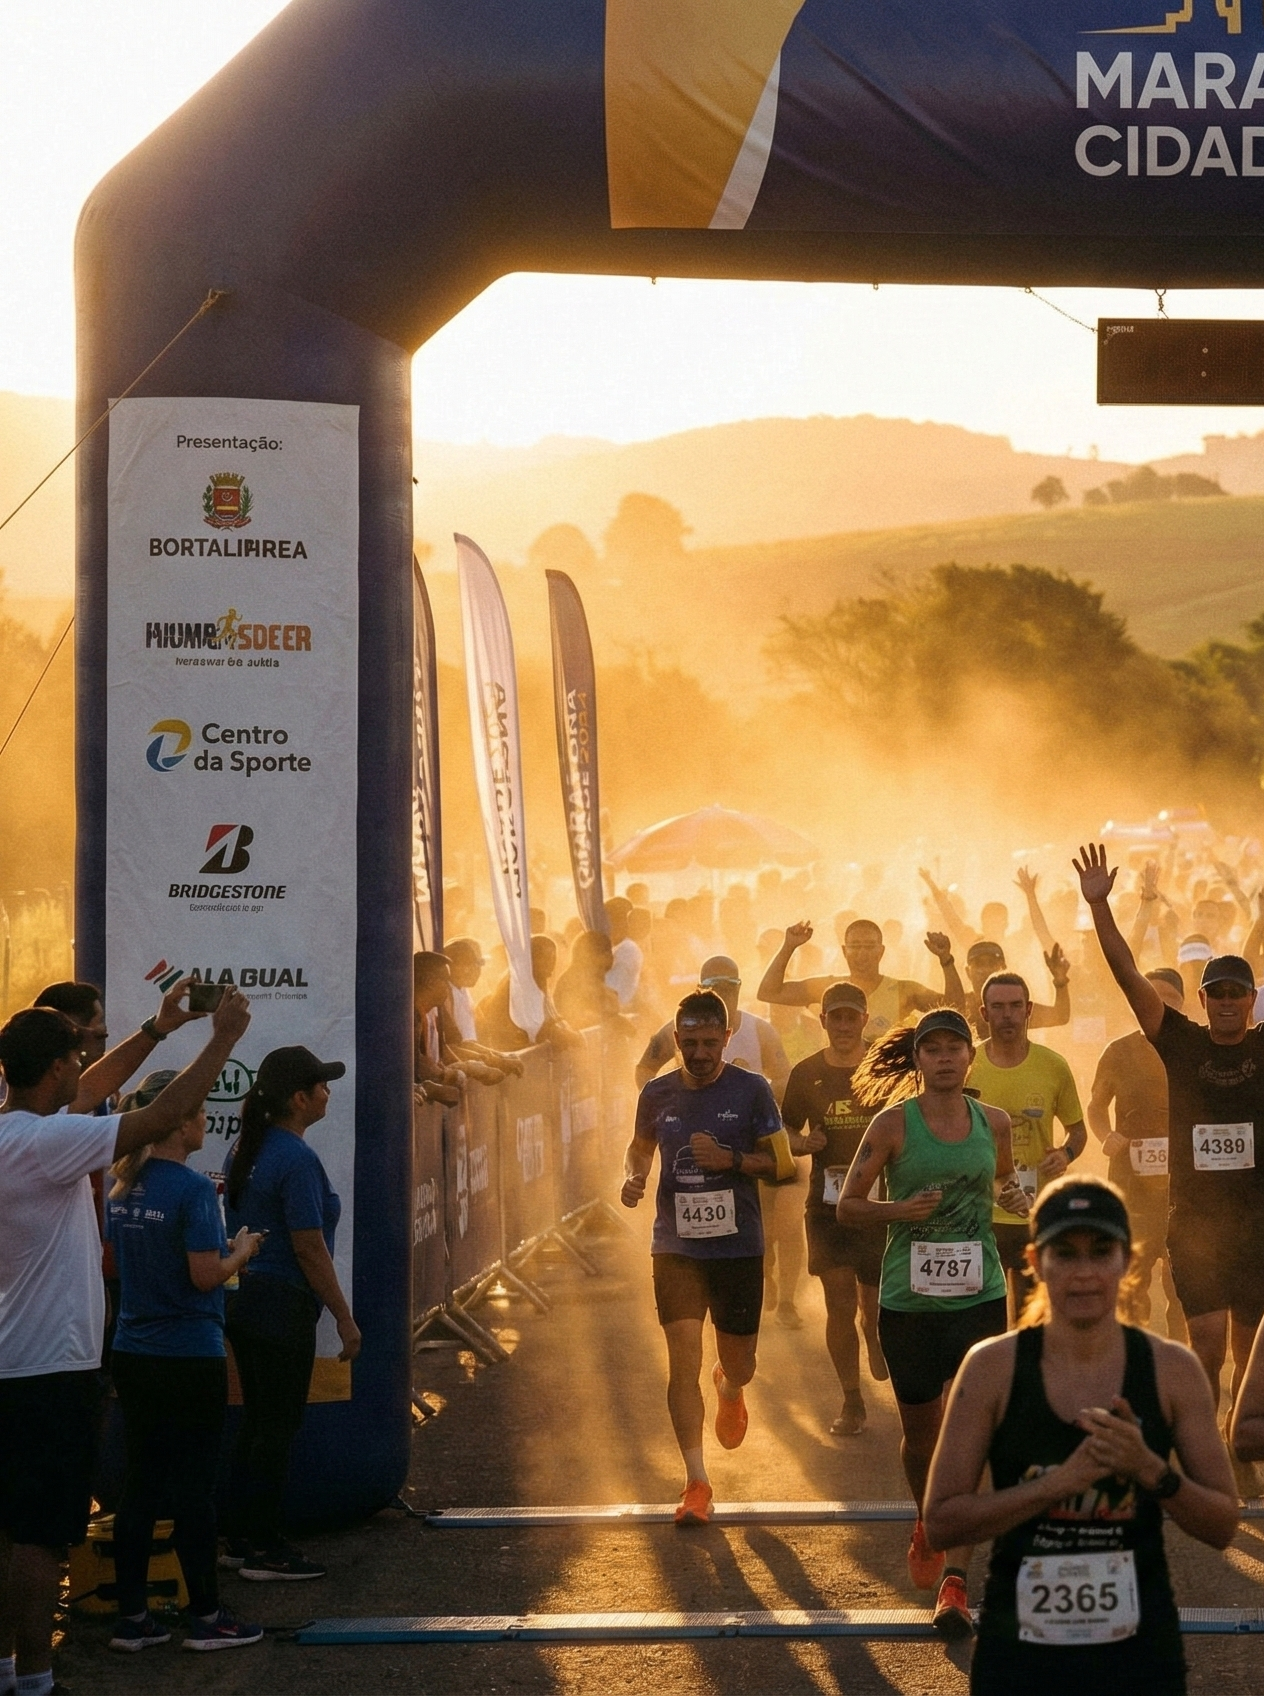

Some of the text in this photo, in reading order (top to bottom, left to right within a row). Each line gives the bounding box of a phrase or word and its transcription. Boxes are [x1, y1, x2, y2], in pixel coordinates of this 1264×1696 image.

[176, 435, 283, 452] Presentação:
[201, 722, 289, 744] Centro
[193, 750, 312, 777] da Sporte
[168, 884, 287, 899] BRIDGESTONE
[240, 968, 308, 988] GUAL
[682, 1204, 727, 1223] 4430
[919, 1258, 973, 1278] 4787
[1031, 1582, 1119, 1614] 2365
